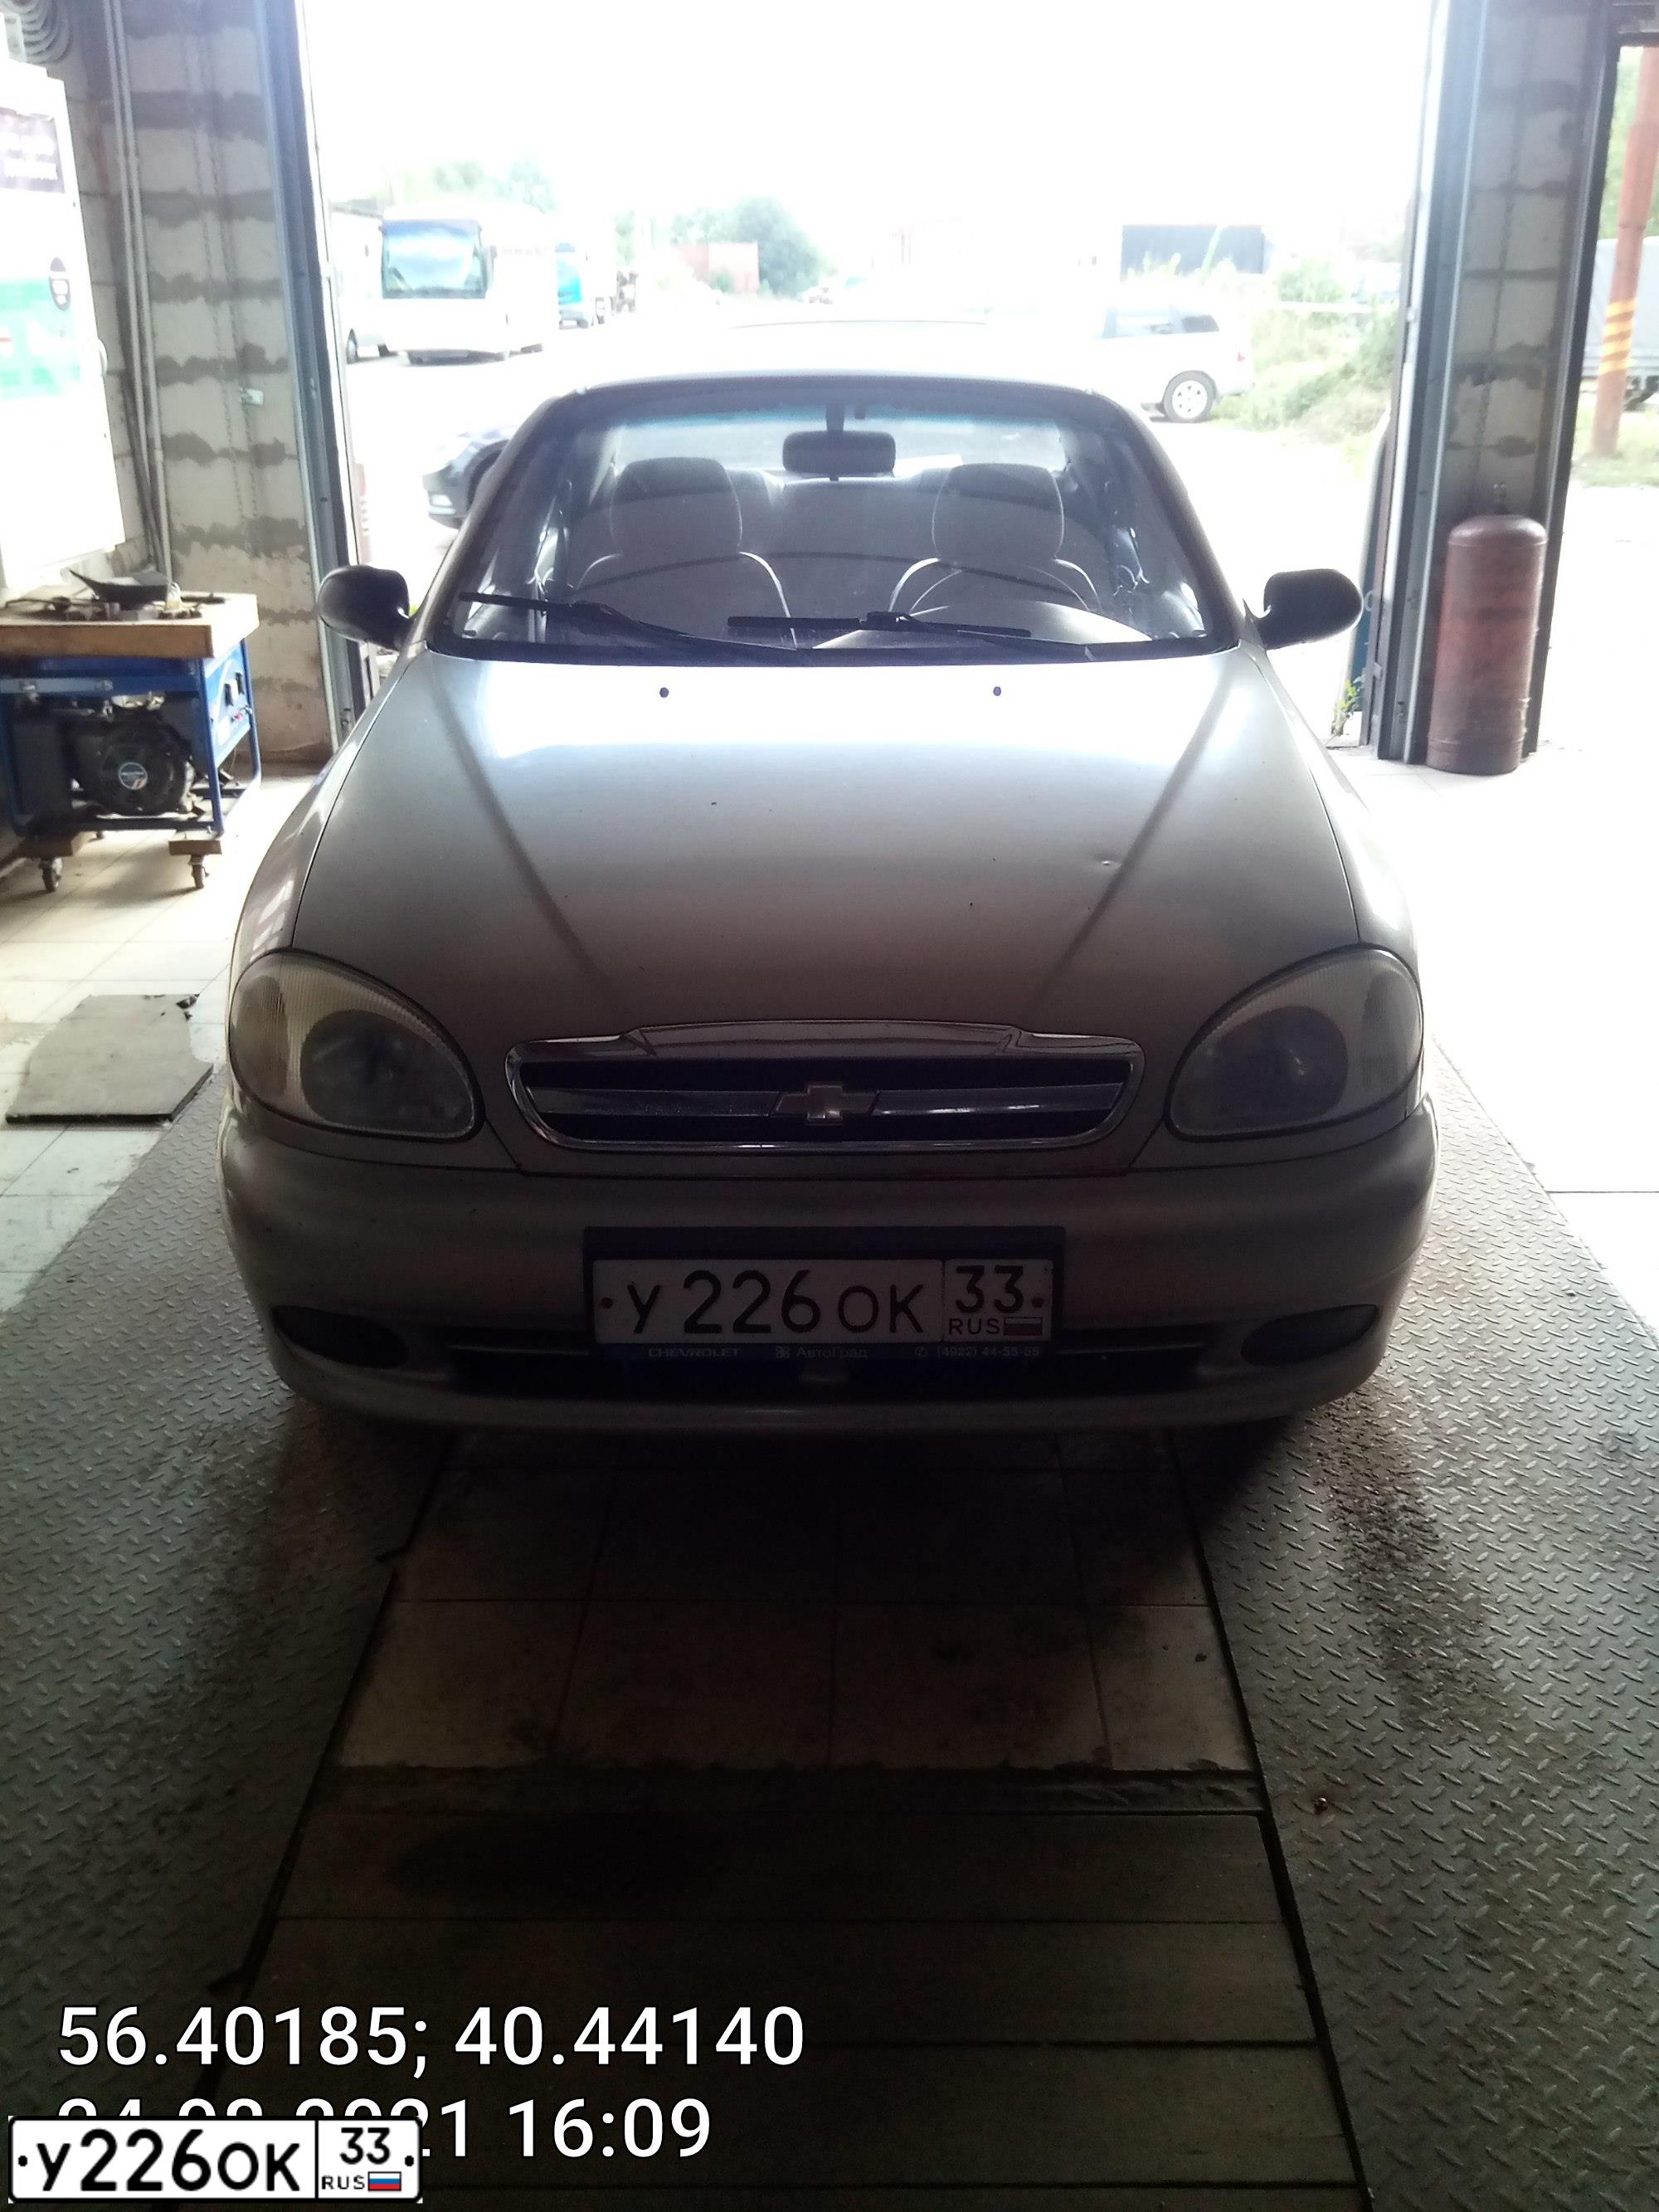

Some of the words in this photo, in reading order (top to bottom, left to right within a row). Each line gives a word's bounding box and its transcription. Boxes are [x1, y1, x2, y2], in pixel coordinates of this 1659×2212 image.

[956, 1265, 1024, 1315] 33
[949, 1318, 1000, 1335] RUS
[649, 1347, 741, 1358] CHEVROLET
[795, 1346, 868, 1359] АвтоГрад
